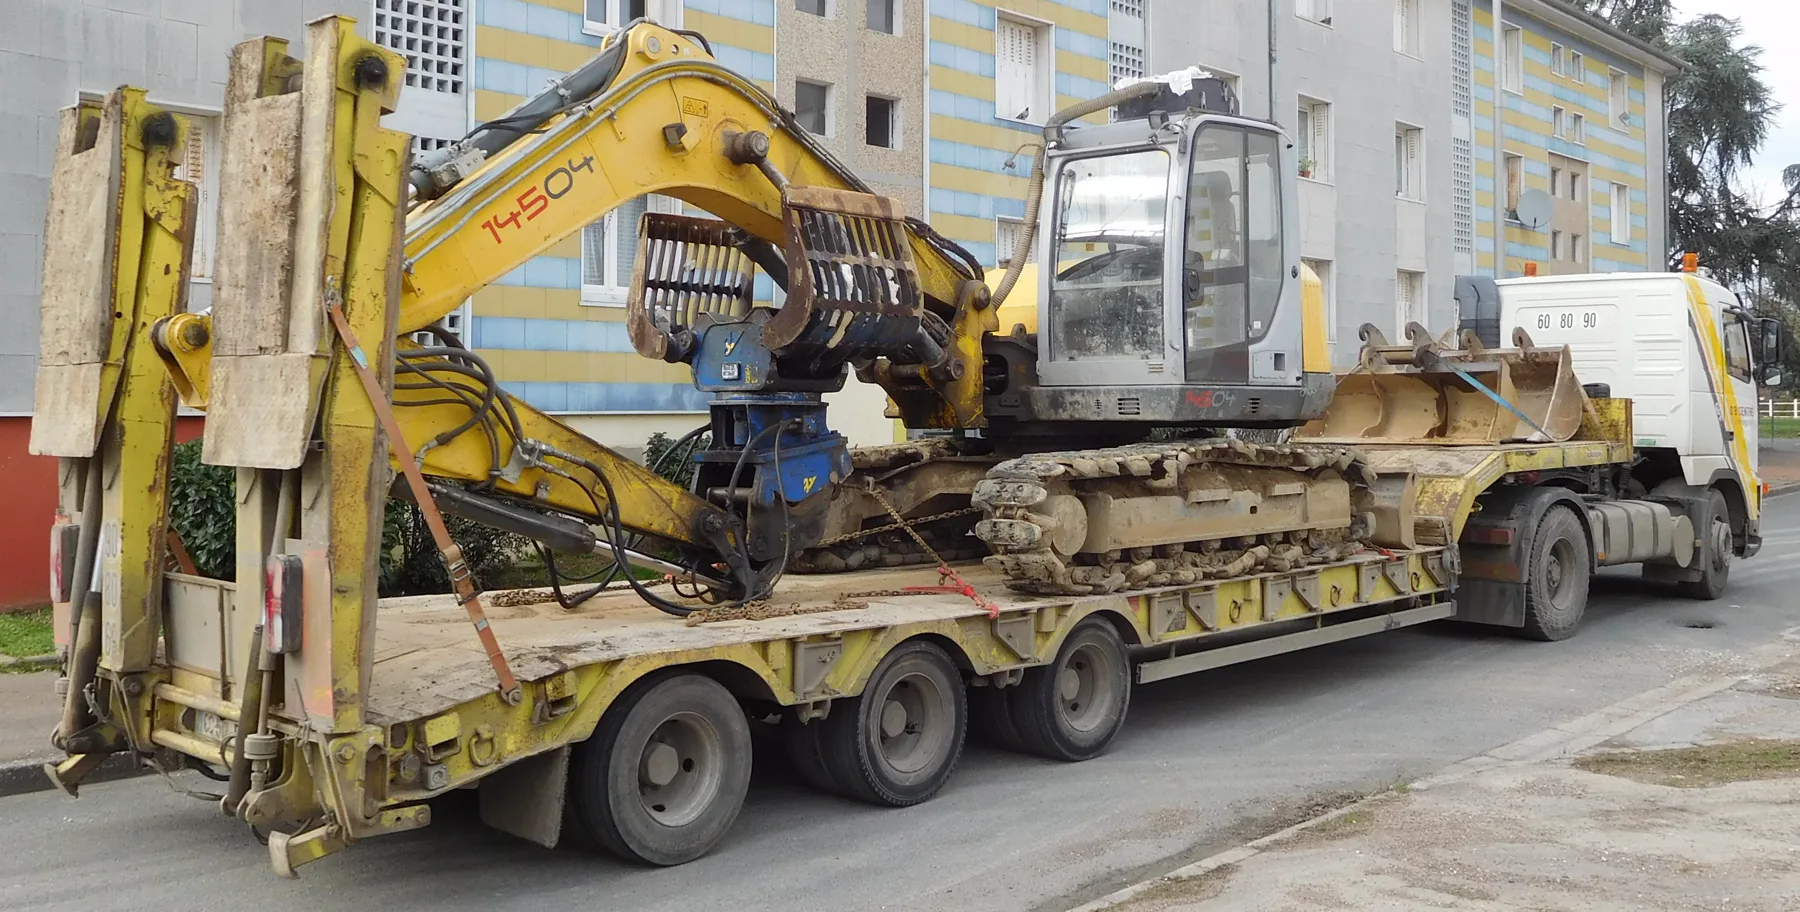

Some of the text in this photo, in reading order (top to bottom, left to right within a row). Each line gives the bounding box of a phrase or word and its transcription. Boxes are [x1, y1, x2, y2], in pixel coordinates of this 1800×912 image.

[481, 155, 594, 244] 14504
[1537, 311, 1597, 329] 60 80 90
[104, 571, 118, 608] 80
